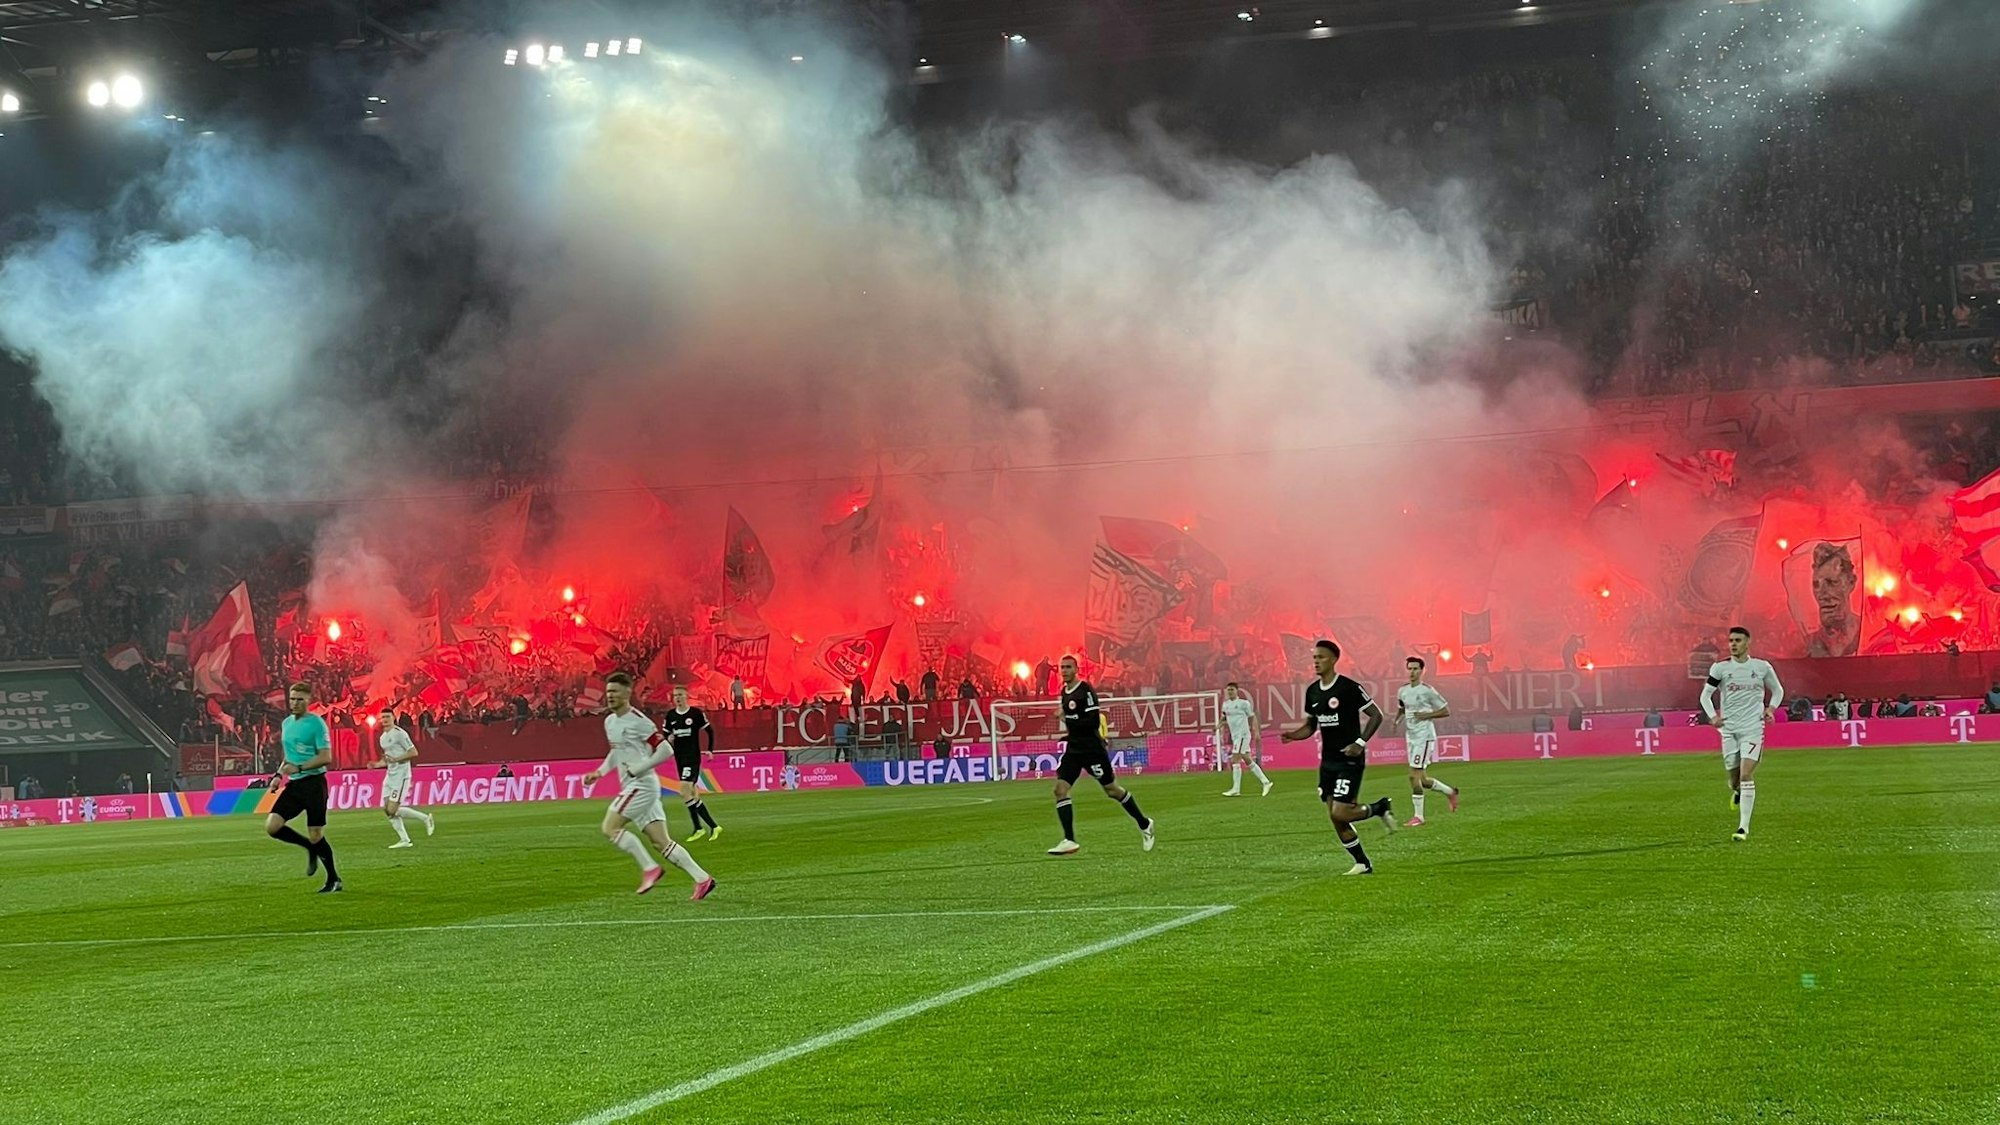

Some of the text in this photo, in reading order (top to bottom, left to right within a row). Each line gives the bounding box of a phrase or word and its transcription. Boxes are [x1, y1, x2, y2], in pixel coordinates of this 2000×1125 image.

[777, 706, 826, 743] FC
[941, 698, 1016, 738] JAS
[1748, 742, 1756, 755] 7
[1414, 754, 1421, 765] 8
[802, 774, 838, 783] EURO2024
[391, 789, 398, 799] 6
[428, 775, 558, 805] MAGENTA
